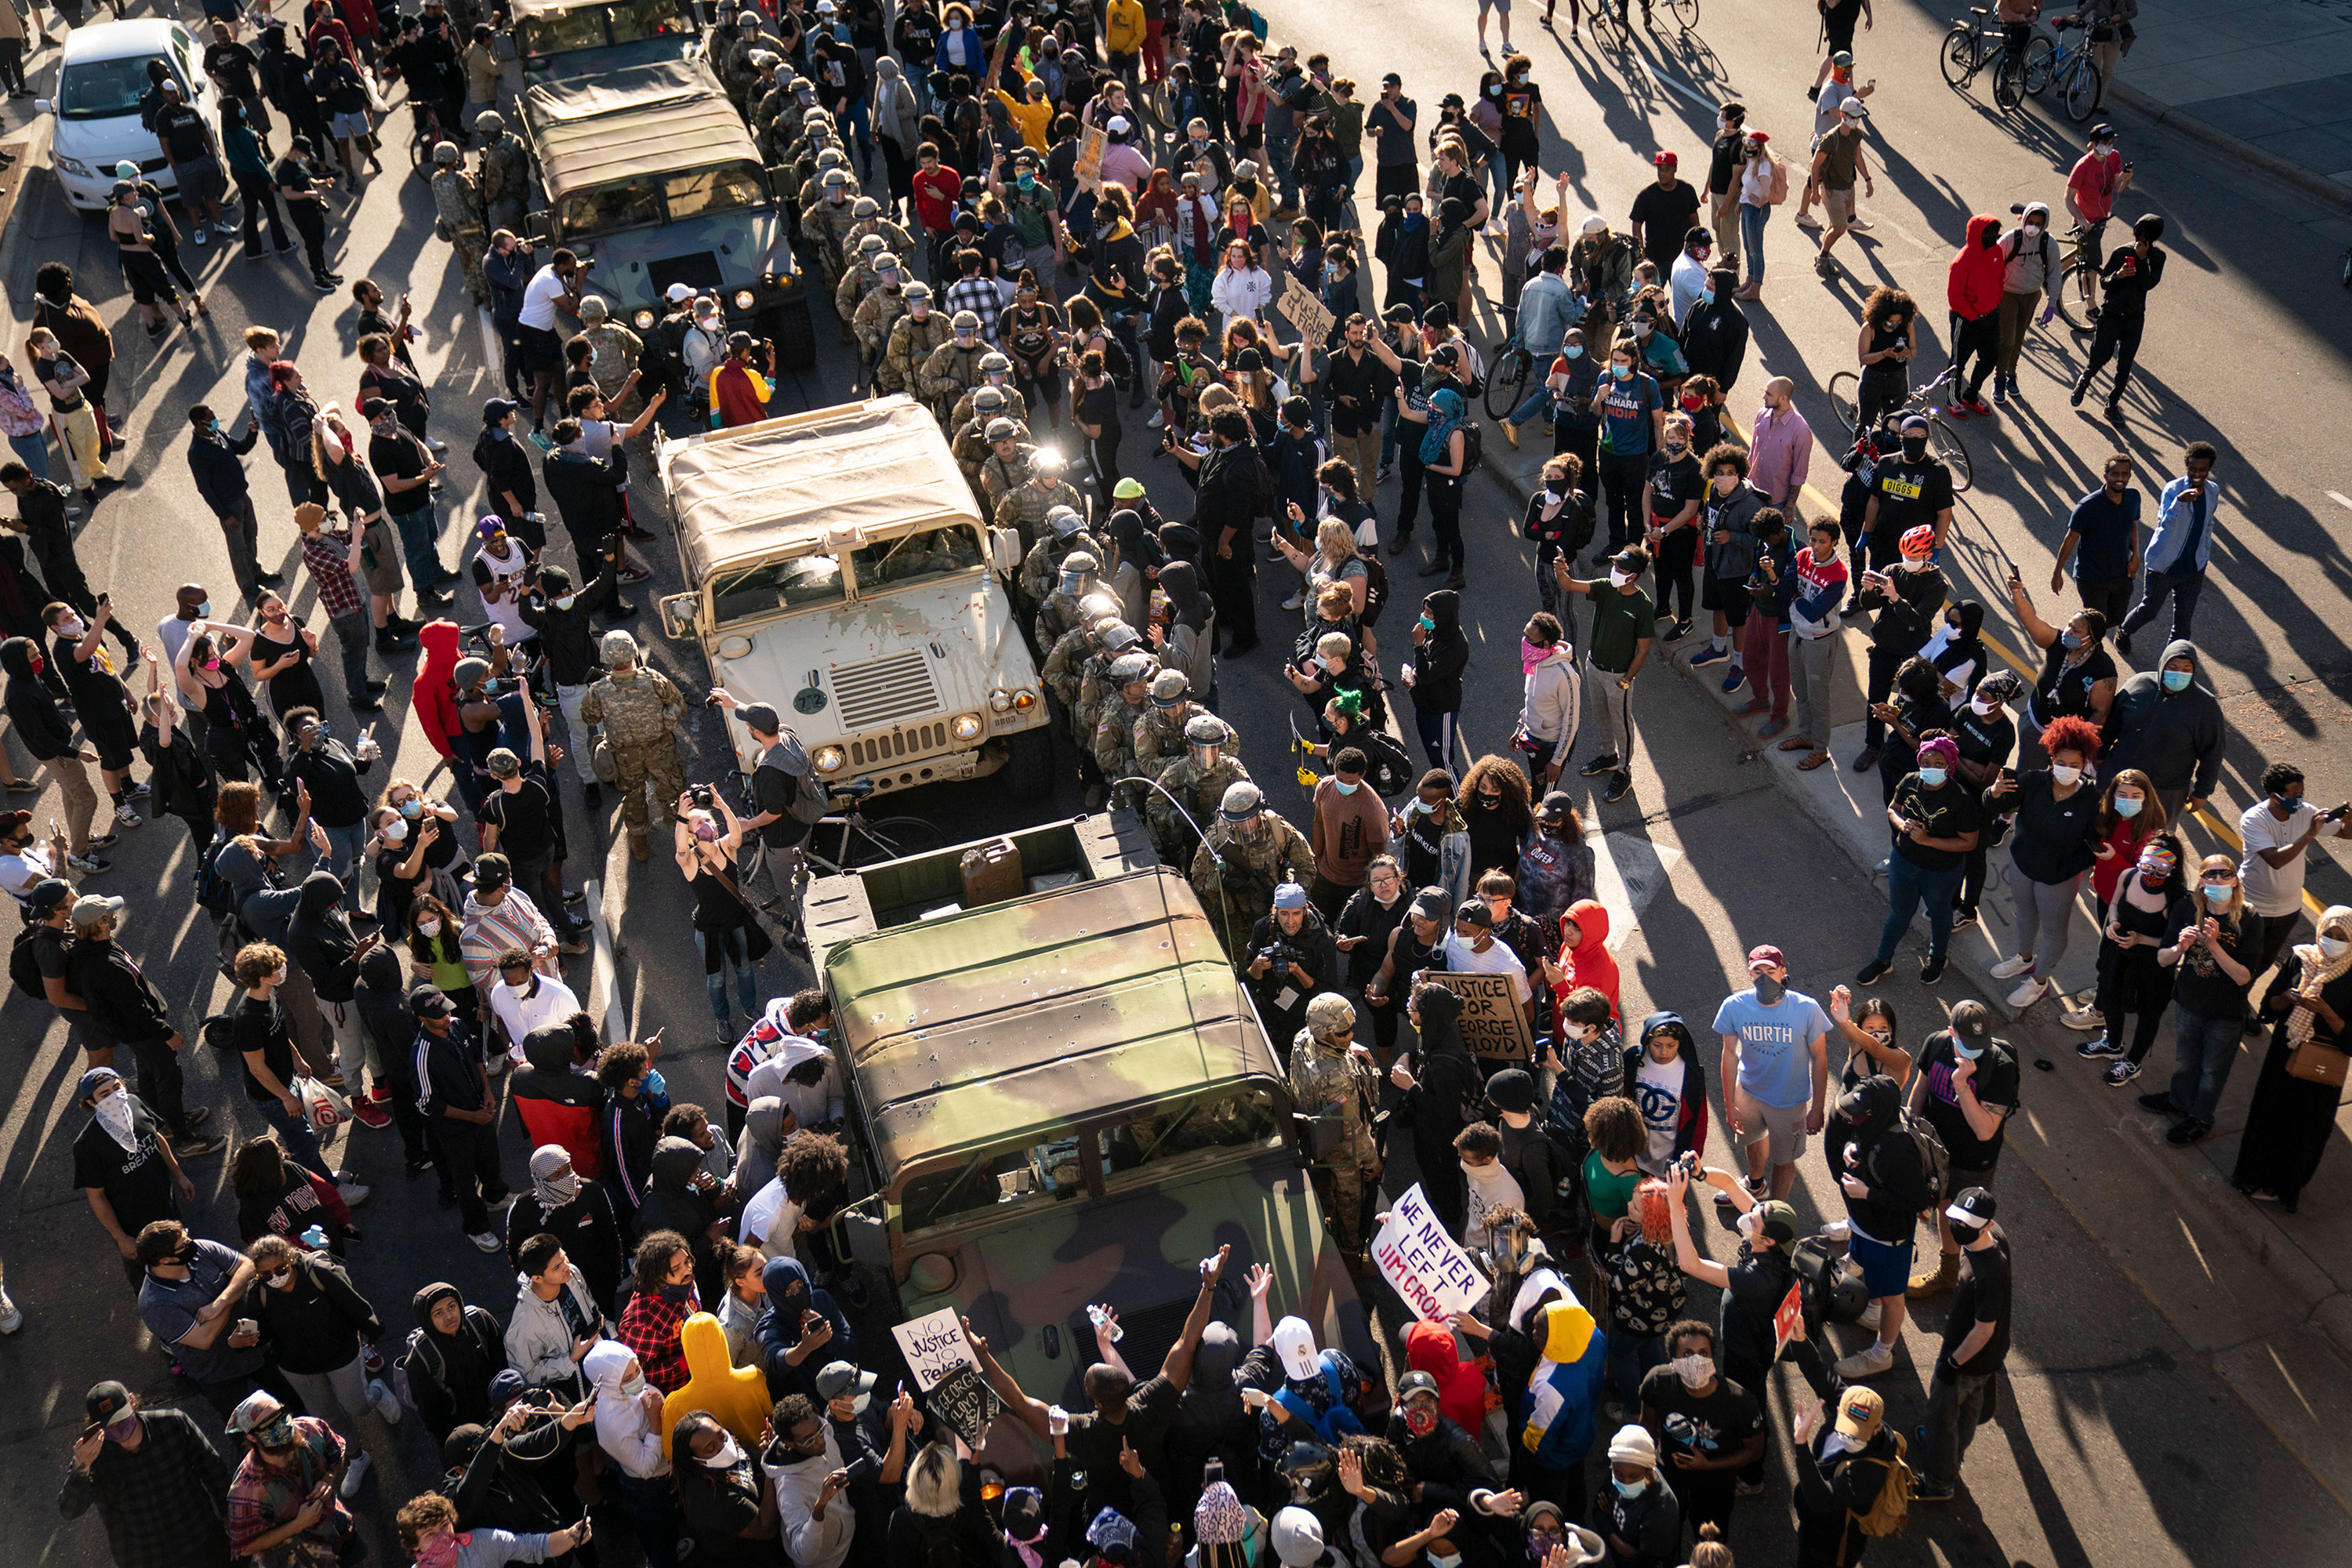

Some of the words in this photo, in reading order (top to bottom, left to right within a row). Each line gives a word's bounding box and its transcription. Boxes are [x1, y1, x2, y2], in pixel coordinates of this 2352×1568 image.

[1287, 299, 1295, 320] 4
[1606, 396, 1639, 409] SAHARA
[1606, 405, 1637, 419] NDIA
[1887, 481, 1912, 495] DIGGS
[1913, 475, 1924, 485] 14
[1459, 1019, 1515, 1036] EORGE
[1742, 1025, 1793, 1044] NORTH
[1964, 1196, 1975, 1209] D
[267, 1206, 291, 1232] EW
[1400, 1192, 1424, 1226] WE
[1417, 1226, 1474, 1295] NEVER
[1378, 1243, 1407, 1280] JIM
[1403, 1276, 1450, 1324] CROW
[907, 1319, 944, 1341] NO
[922, 1348, 956, 1369] NO
[950, 1392, 980, 1422] FLOYD
